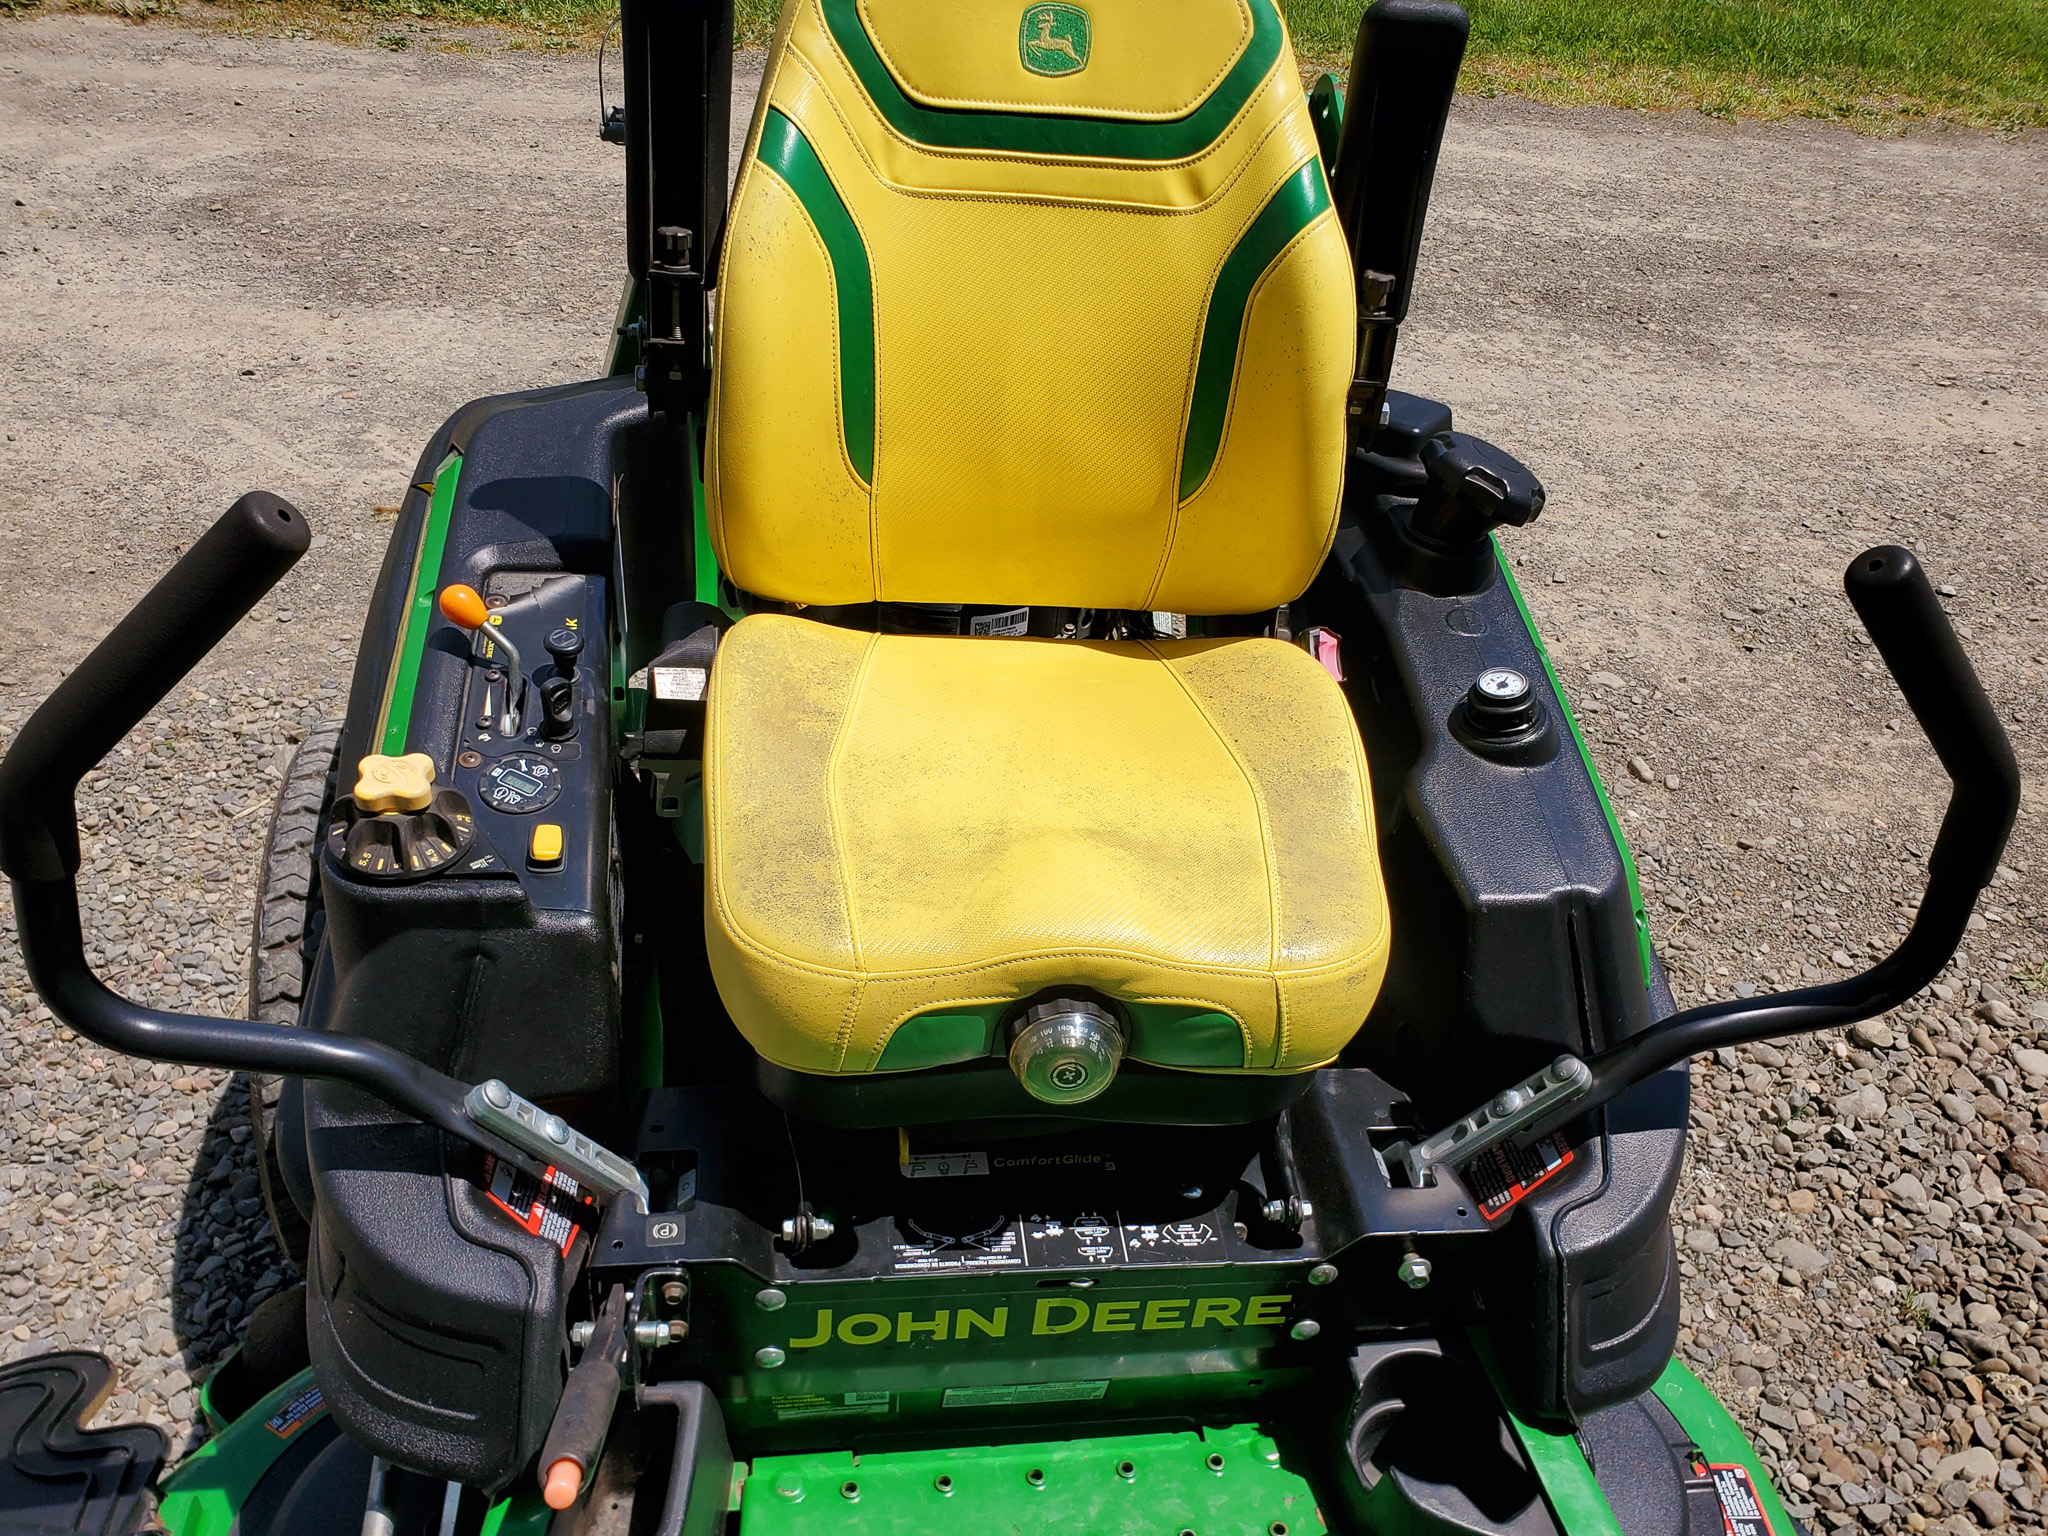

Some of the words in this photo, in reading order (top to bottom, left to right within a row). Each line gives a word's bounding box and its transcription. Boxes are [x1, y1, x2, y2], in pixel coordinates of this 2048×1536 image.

[456, 814, 472, 823] 3.5
[358, 851, 372, 867] 5.5
[993, 1153, 1103, 1168] ComfortGlide
[789, 1306, 1009, 1348] JOHN
[1031, 1294, 1293, 1336] DEERE
